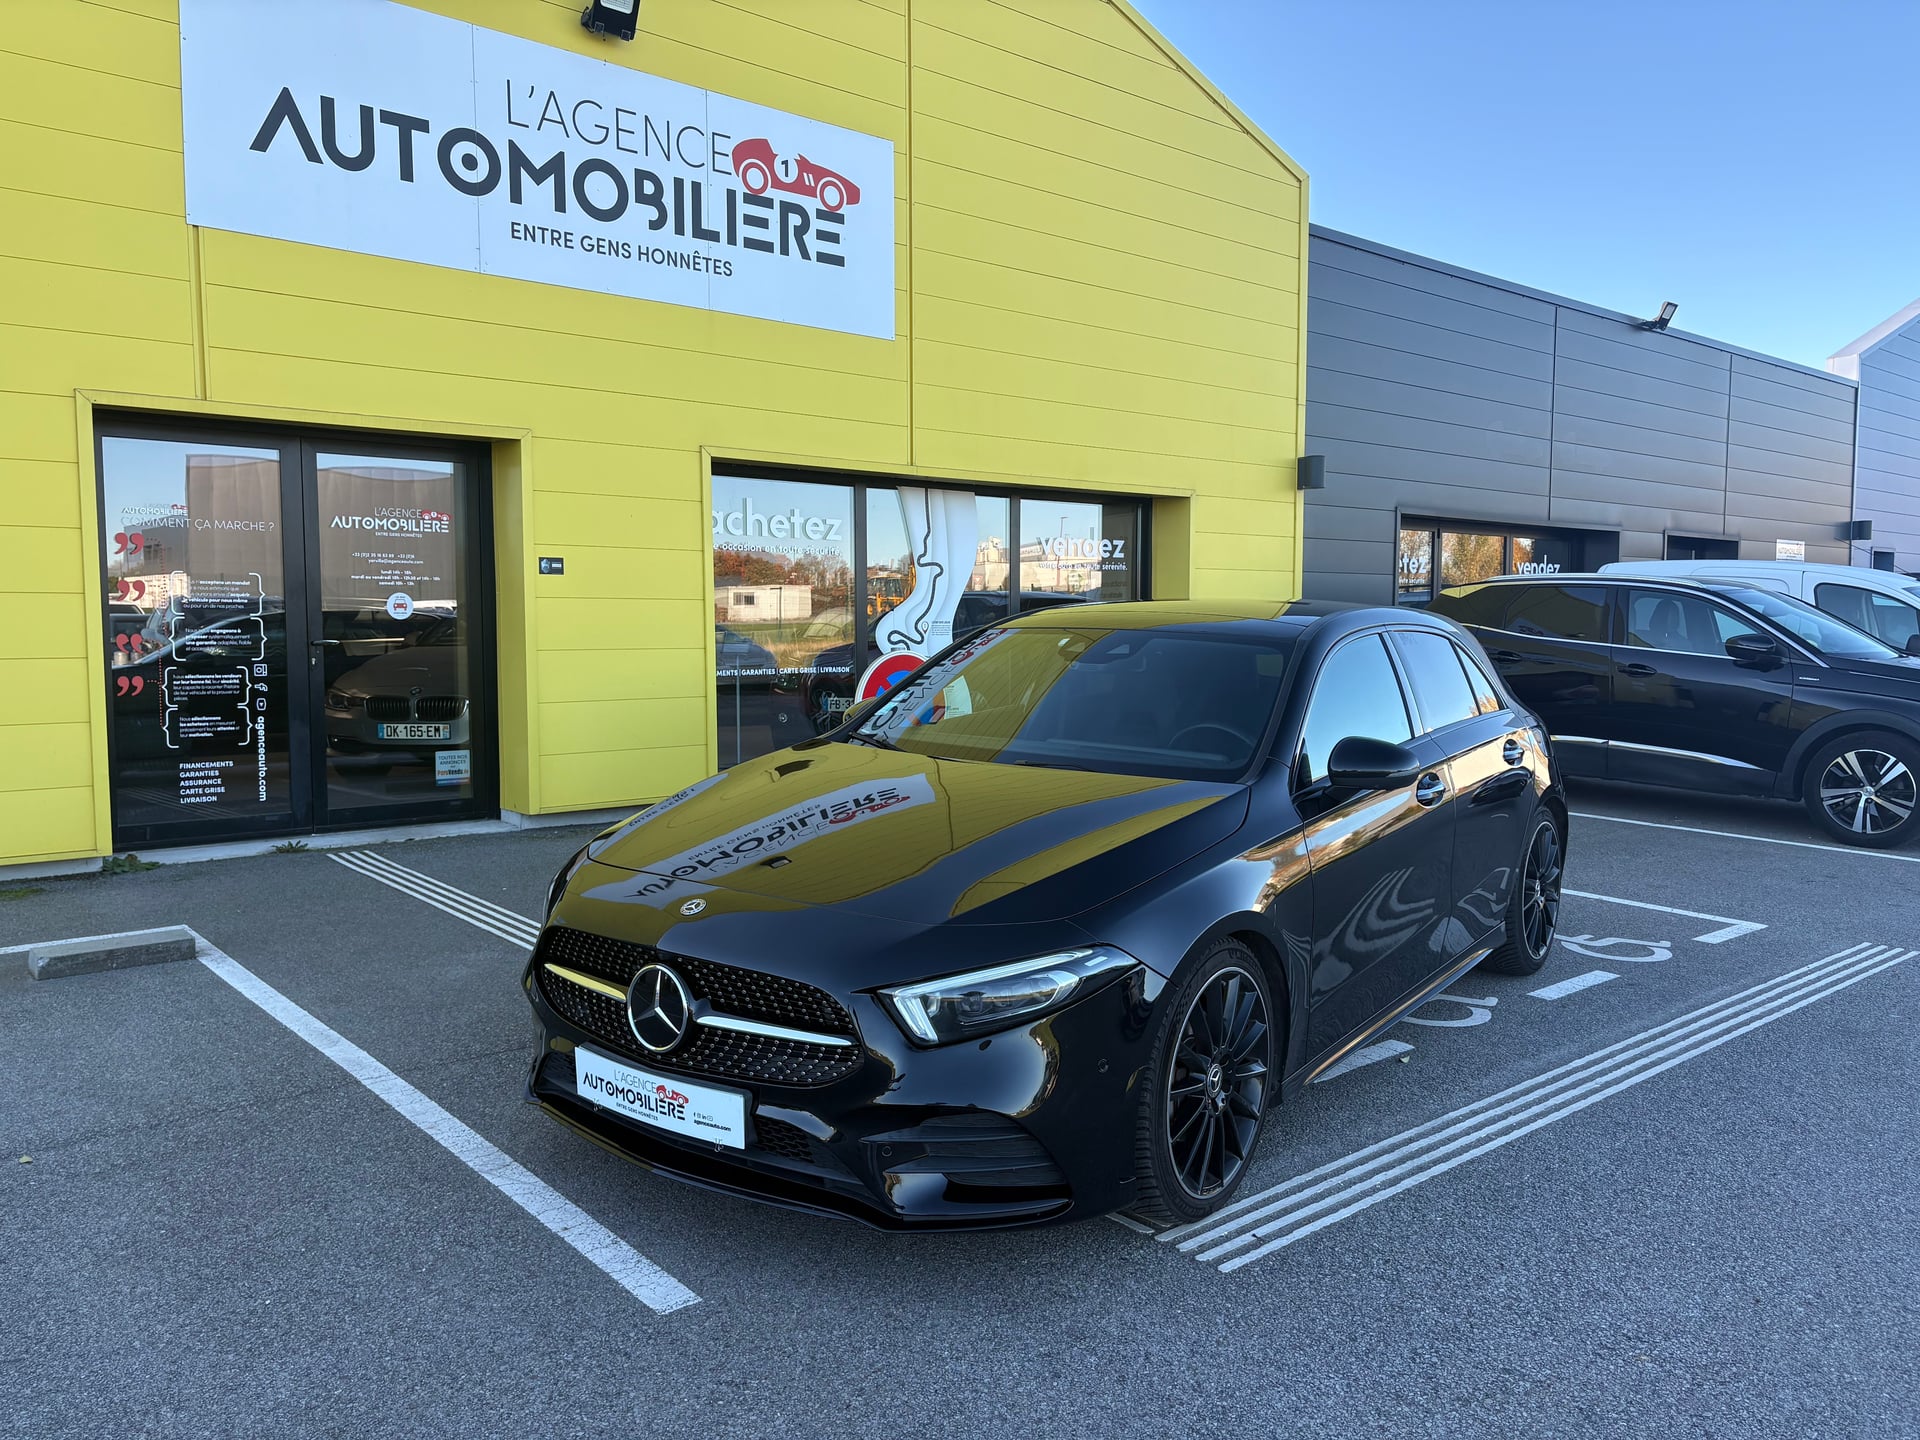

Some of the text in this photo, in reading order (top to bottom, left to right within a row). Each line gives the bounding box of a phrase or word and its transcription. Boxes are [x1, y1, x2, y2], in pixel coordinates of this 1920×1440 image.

[506, 79, 732, 175] L'AGENCE
[249, 86, 845, 268] AUTOMOBILIERE
[511, 221, 733, 277] ENTRE GENS HONNÊTES
[374, 507, 422, 519] L'AGENCE
[712, 497, 842, 541] achetez
[120, 517, 275, 532] COMMENT ÇA MARCHE ?
[330, 515, 449, 533] AUTOMOBILIERE
[722, 543, 762, 552] occasion
[1040, 527, 1125, 559] vendez
[1517, 554, 1561, 574] vendez
[741, 668, 776, 676] GARANTIES
[385, 725, 441, 738] DK-165-EM
[180, 761, 234, 769] FINANCEMENTS
[254, 716, 268, 802] agenceauto.com
[180, 770, 220, 778] GARANTIES
[180, 778, 222, 787] ASSURANCE
[180, 795, 218, 804] LIVRAISON
[614, 1069, 657, 1094] L'AGENCE
[583, 1071, 686, 1121] AUTOMOBILIERE
